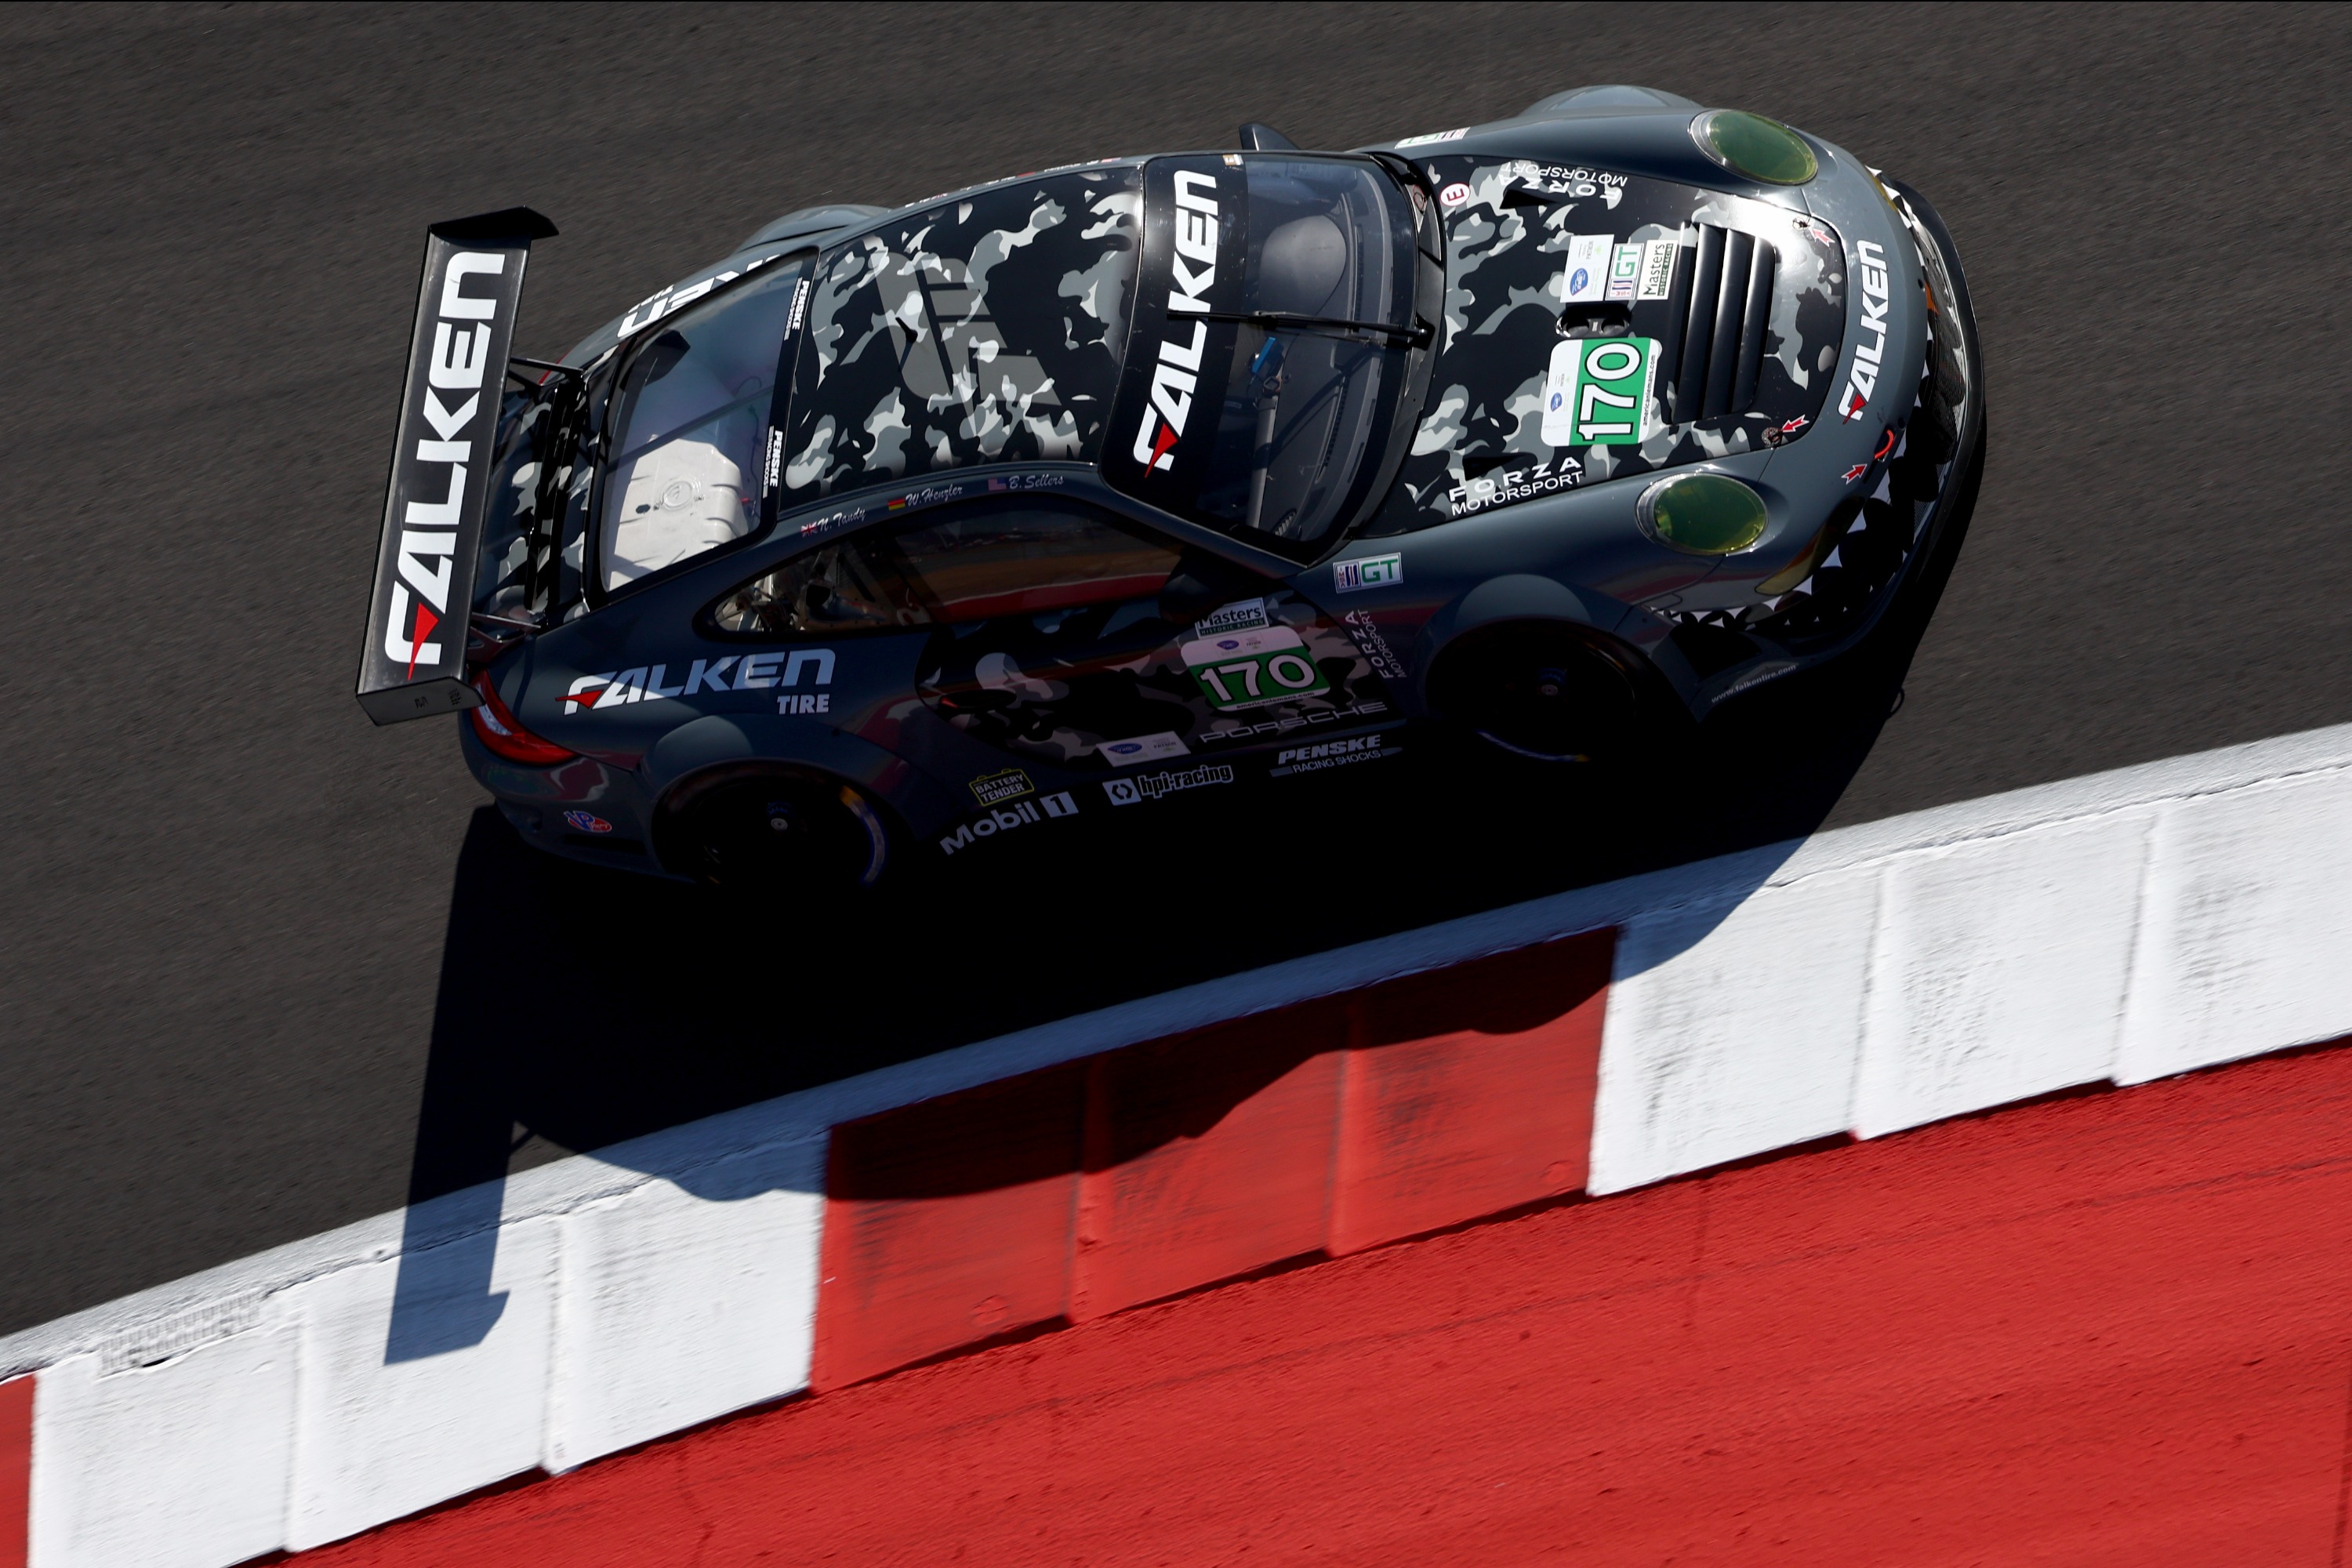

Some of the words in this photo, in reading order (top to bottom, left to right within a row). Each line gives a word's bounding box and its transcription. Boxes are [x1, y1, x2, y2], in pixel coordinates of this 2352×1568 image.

[1446, 187, 1465, 201] E
[1501, 162, 1628, 187] MOTORSPORT
[1615, 246, 1638, 277] GT
[1643, 245, 1665, 295] Masters
[1133, 170, 1219, 479] FALKEN
[1838, 240, 1889, 424] FALKEN
[1577, 342, 1642, 441] 170
[385, 252, 505, 679] FALKEN
[769, 430, 783, 488] PENSKE
[1449, 456, 1581, 502] FORZA
[1451, 470, 1584, 517] MOTORSPORT
[1361, 558, 1399, 583] GT
[1200, 607, 1262, 628] Masters
[1201, 622, 1235, 636] HISTORIC
[1236, 618, 1265, 630] RACING
[1345, 610, 1394, 679] FORZA
[1357, 609, 1407, 678] MOTORSPORT
[556, 648, 836, 716] FALKEN
[1200, 653, 1316, 702] 170
[1711, 664, 1797, 703] www.falkentire.com
[777, 694, 830, 715] TIRE
[1200, 701, 1388, 743] PORSCHE
[1278, 735, 1381, 764] PENSKE
[1292, 758, 1335, 774] RACING
[1335, 750, 1382, 766] SHOCKS
[975, 774, 1024, 795] BATTERY
[980, 783, 1025, 804] TENDER
[1138, 765, 1233, 798] hpi-racing
[939, 800, 1041, 856] Mobil
